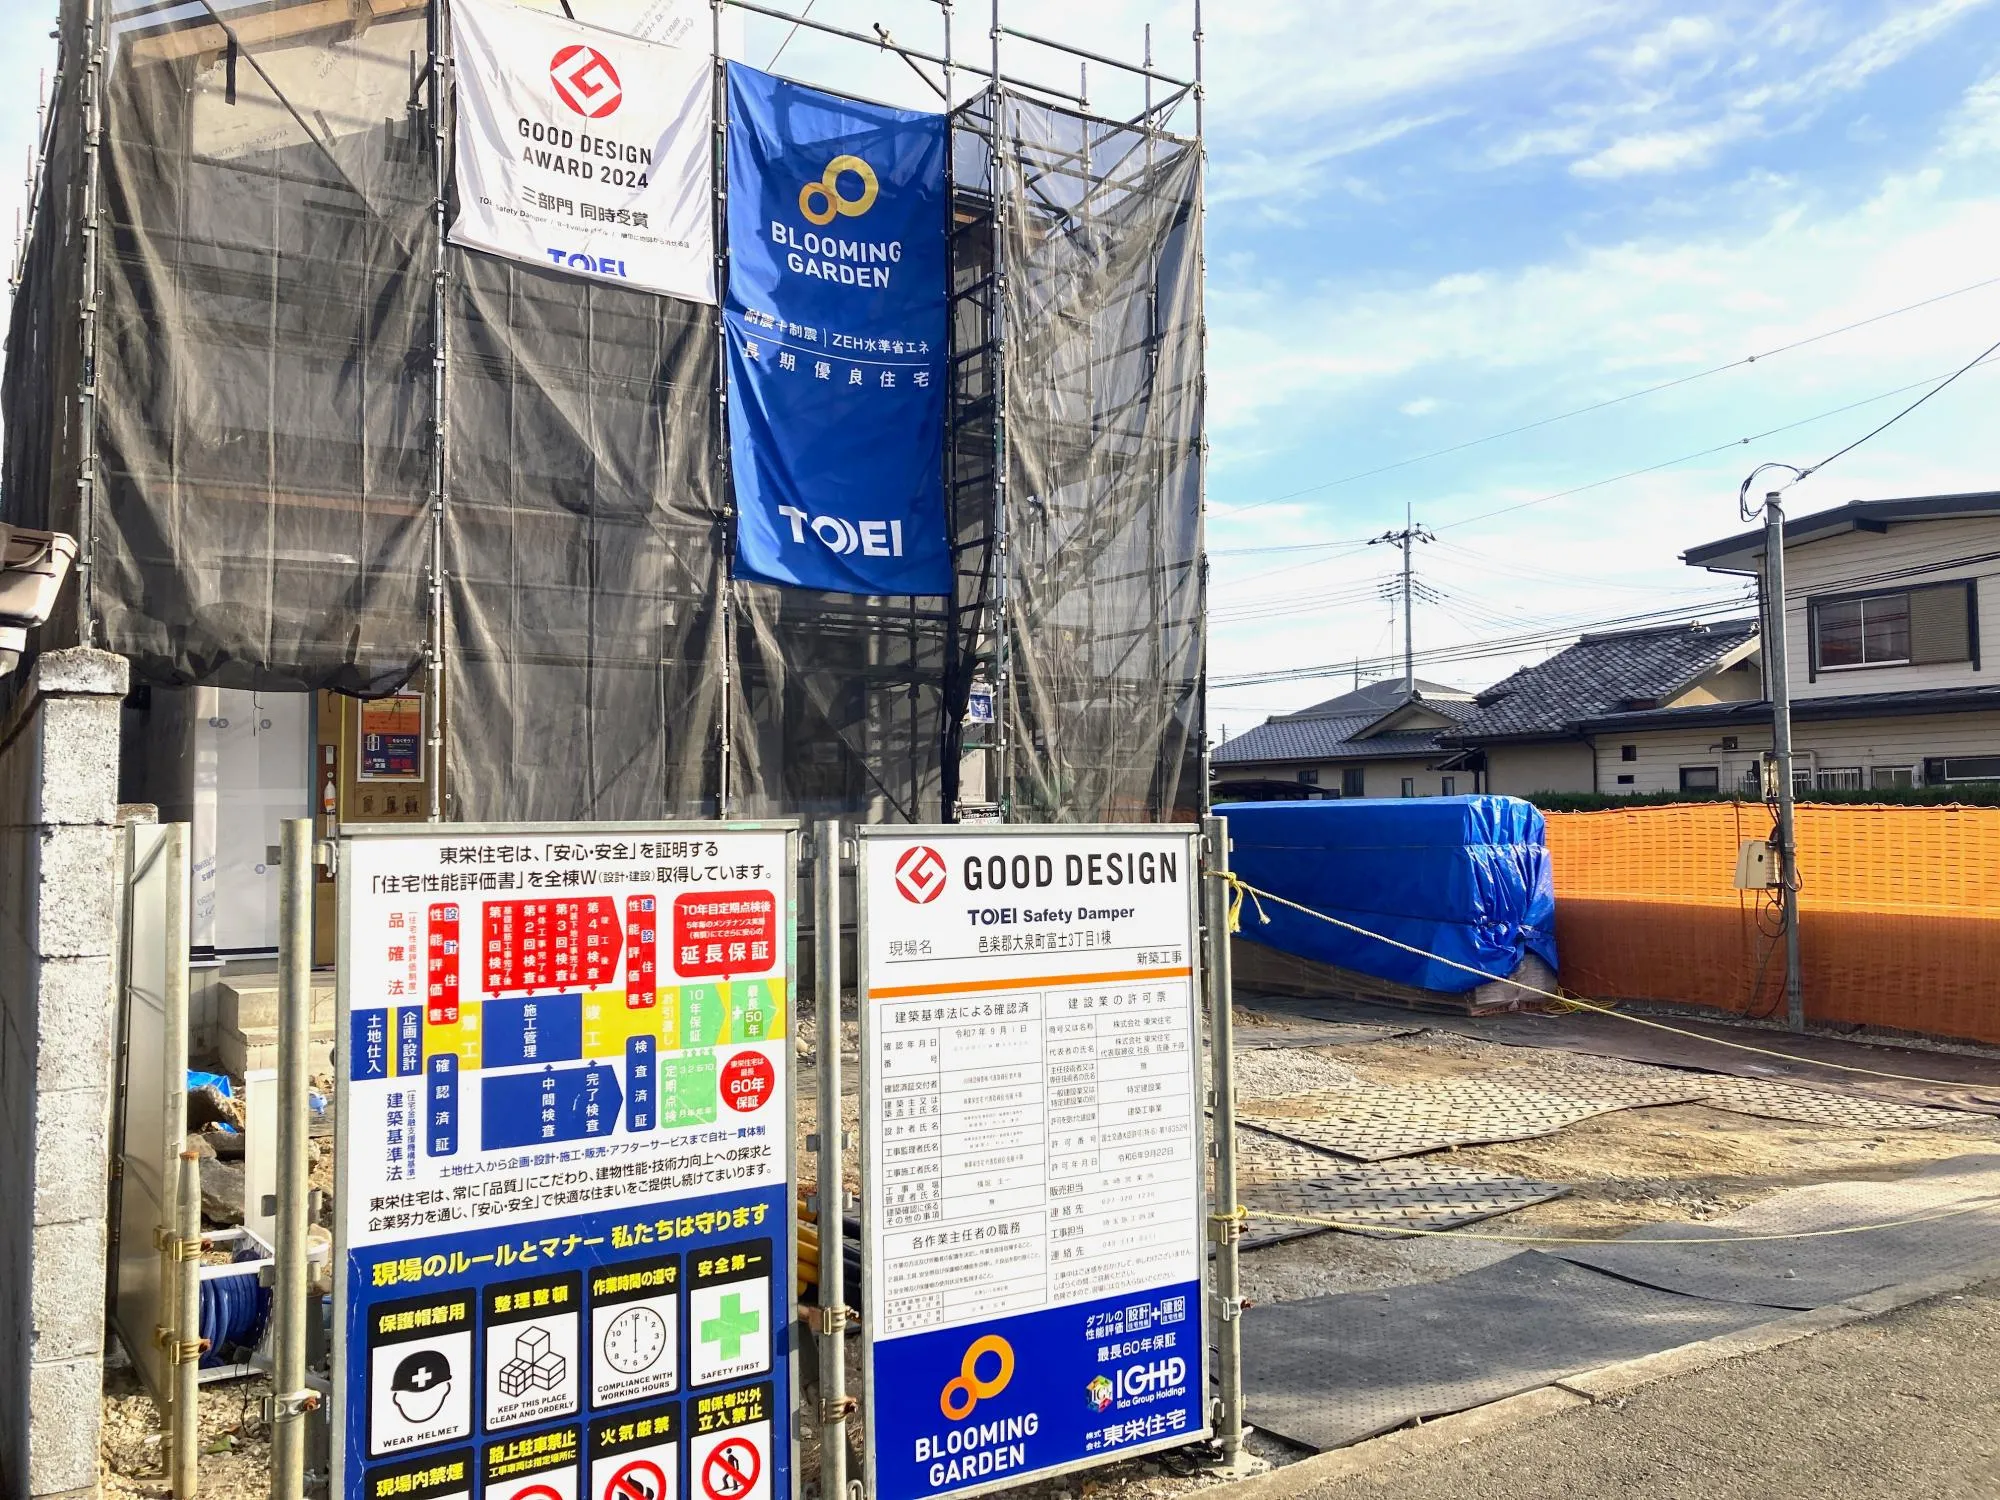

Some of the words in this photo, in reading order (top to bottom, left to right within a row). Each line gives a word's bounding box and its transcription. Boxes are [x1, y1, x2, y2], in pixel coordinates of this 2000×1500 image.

[518, 118, 573, 149] GOOD
[580, 134, 652, 165] DESIGN
[523, 146, 593, 179] AWARD
[600, 165, 649, 189] 2024
[521, 185, 573, 215] 三部門
[580, 202, 649, 229] 同時受賞
[771, 220, 902, 264] BLOOMING
[786, 253, 890, 289] GARDEN
[832, 333, 930, 355] ZEH水準省エネ
[742, 341, 930, 388] 長期優良住宅
[778, 504, 903, 557] TOEI
[963, 854, 1052, 891] GOOD
[1065, 852, 1177, 887] DESIGN
[967, 908, 1018, 926] TOEI
[1022, 909, 1072, 924] Safety
[1077, 907, 1135, 922] Damper
[388, 912, 404, 996] 品確法
[681, 940, 769, 965] 延長保証
[888, 939, 933, 957] 現場名
[1136, 950, 1182, 966] 新築工事
[895, 1001, 1029, 1025] 建築基準法による確認済
[1068, 990, 1166, 1010] 建設業の許可票
[366, 1014, 382, 1073] 土地仕入
[523, 1003, 538, 1058] 施工管理
[634, 1040, 648, 1128] 検査済証
[730, 1077, 765, 1094] 60年
[435, 1058, 450, 1152] 確認済証
[542, 1077, 555, 1138] 中間検査
[586, 1072, 599, 1132] 完了検査
[736, 1095, 758, 1110] 保証
[386, 1092, 403, 1182] 建築基準法
[371, 1233, 604, 1287] 現場のルールとマナー
[611, 1202, 769, 1249] 私たちは守ります
[912, 1223, 1021, 1250] 各作業主任者の職務
[697, 1252, 762, 1277] 安全第一
[592, 1266, 677, 1297] 作業時間の遵守
[494, 1285, 569, 1314] 整理整頓
[378, 1302, 466, 1335] 保護帽着用
[1086, 1310, 1124, 1328] ダブルの
[1086, 1322, 1124, 1341] 性能評価
[1097, 1332, 1177, 1362] 最長60年保証
[597, 1376, 650, 1393] COMPLIANCE
[652, 1371, 673, 1381] WITH
[700, 1367, 733, 1380] SAFETY
[736, 1361, 760, 1372] FIRST
[498, 1404, 519, 1413] KEEP
[521, 1399, 540, 1408] THIS
[541, 1393, 567, 1404] PLACE
[600, 1386, 640, 1401] WORKING
[642, 1381, 670, 1392] HOURS
[1132, 1392, 1155, 1406] Group
[1156, 1385, 1186, 1400] Holdings
[490, 1413, 517, 1424] CLEAN
[519, 1409, 536, 1418] AND
[538, 1401, 574, 1413] ORDERLY
[698, 1405, 763, 1432] 立入禁止
[1102, 1408, 1187, 1448] 東栄住宅
[383, 1435, 413, 1448] WEAR
[417, 1425, 459, 1441] HELMET
[600, 1415, 670, 1447] 火気厳禁
[915, 1412, 1039, 1463] BLOOMING
[489, 1430, 576, 1465] 路上駐車禁止
[376, 1462, 465, 1498] 現場内禁煙
[929, 1442, 1025, 1487] GARDEN
